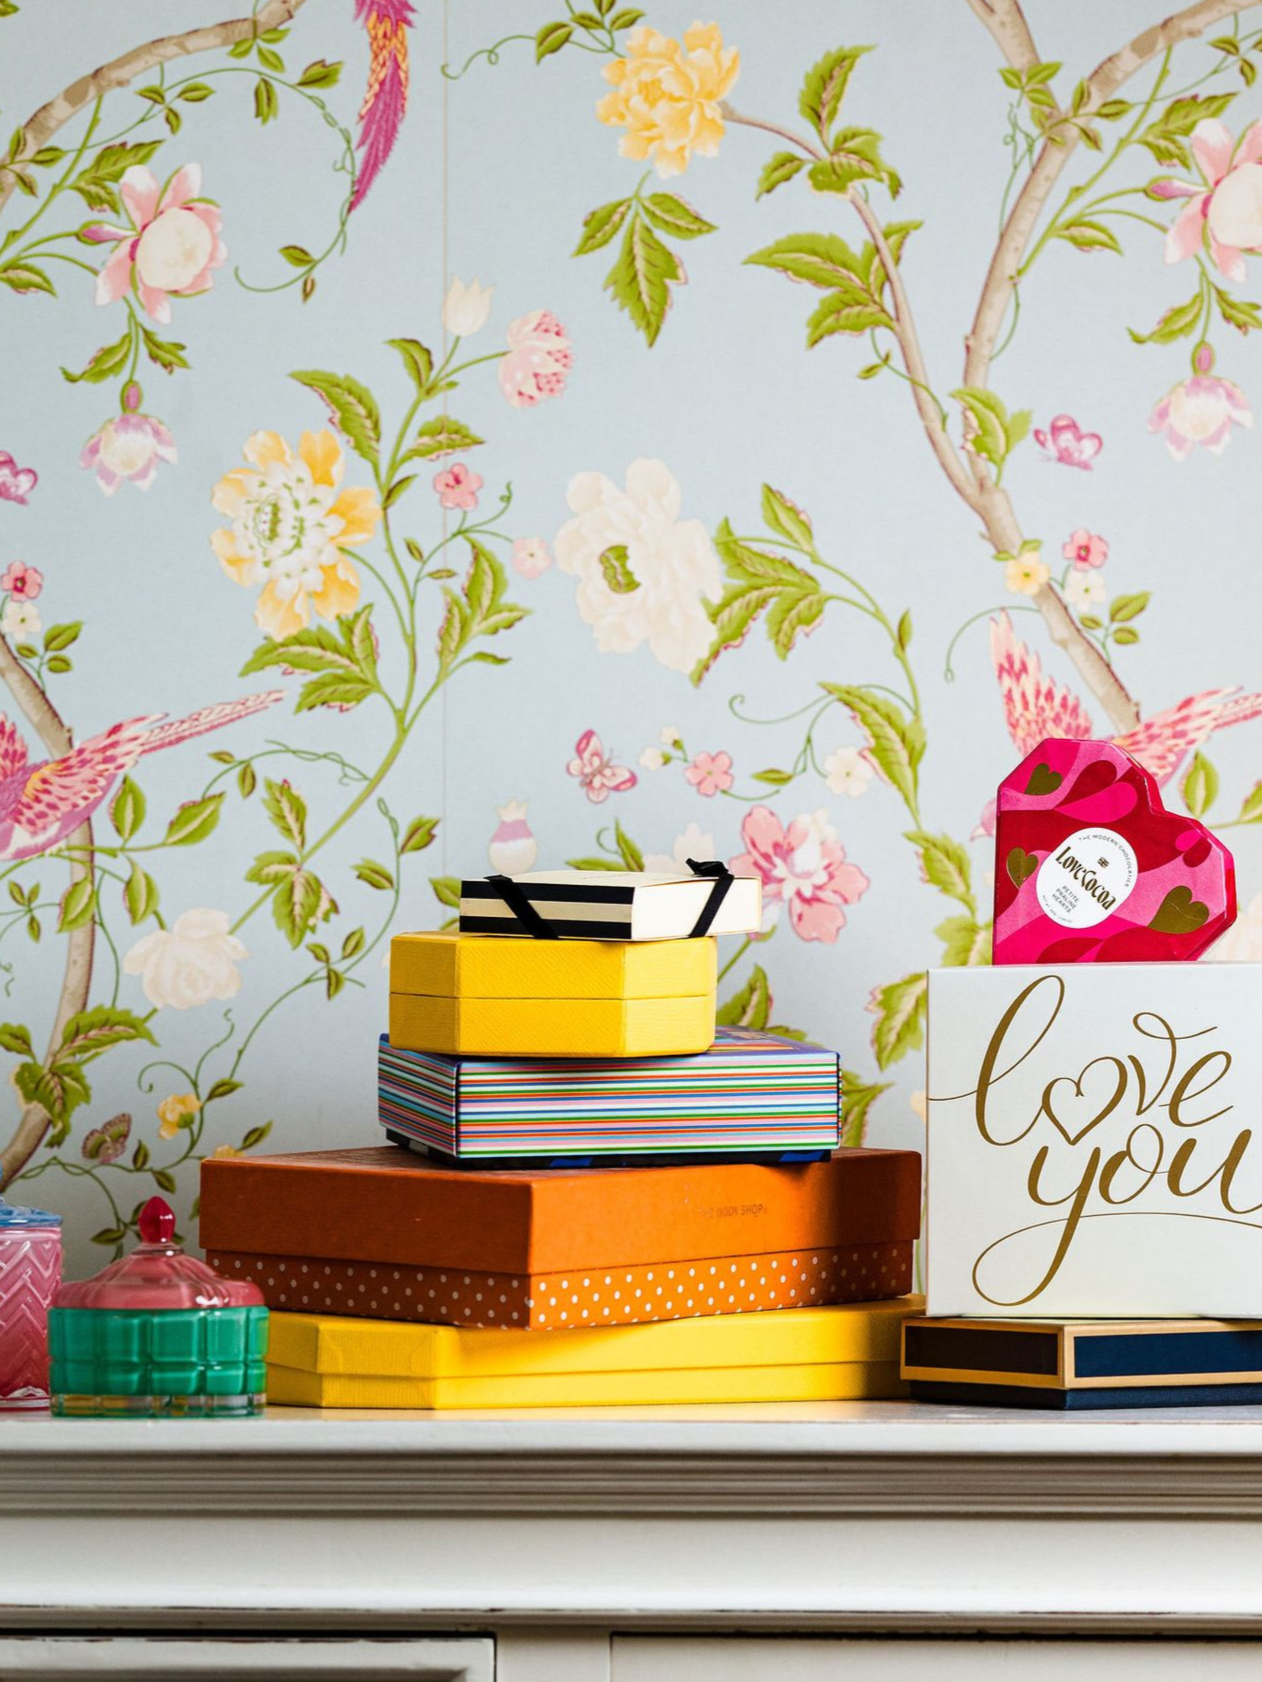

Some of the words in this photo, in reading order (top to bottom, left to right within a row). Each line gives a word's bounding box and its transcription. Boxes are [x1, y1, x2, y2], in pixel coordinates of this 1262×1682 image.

[1092, 834, 1118, 845] MODERN
[1118, 845, 1133, 888] CHOCOLATIER
[1051, 893, 1072, 913] HEARTS
[1055, 888, 1077, 909] PRALINE
[1062, 885, 1079, 902] PETITE
[928, 975, 1234, 1146] love
[972, 1124, 1262, 1307] you
